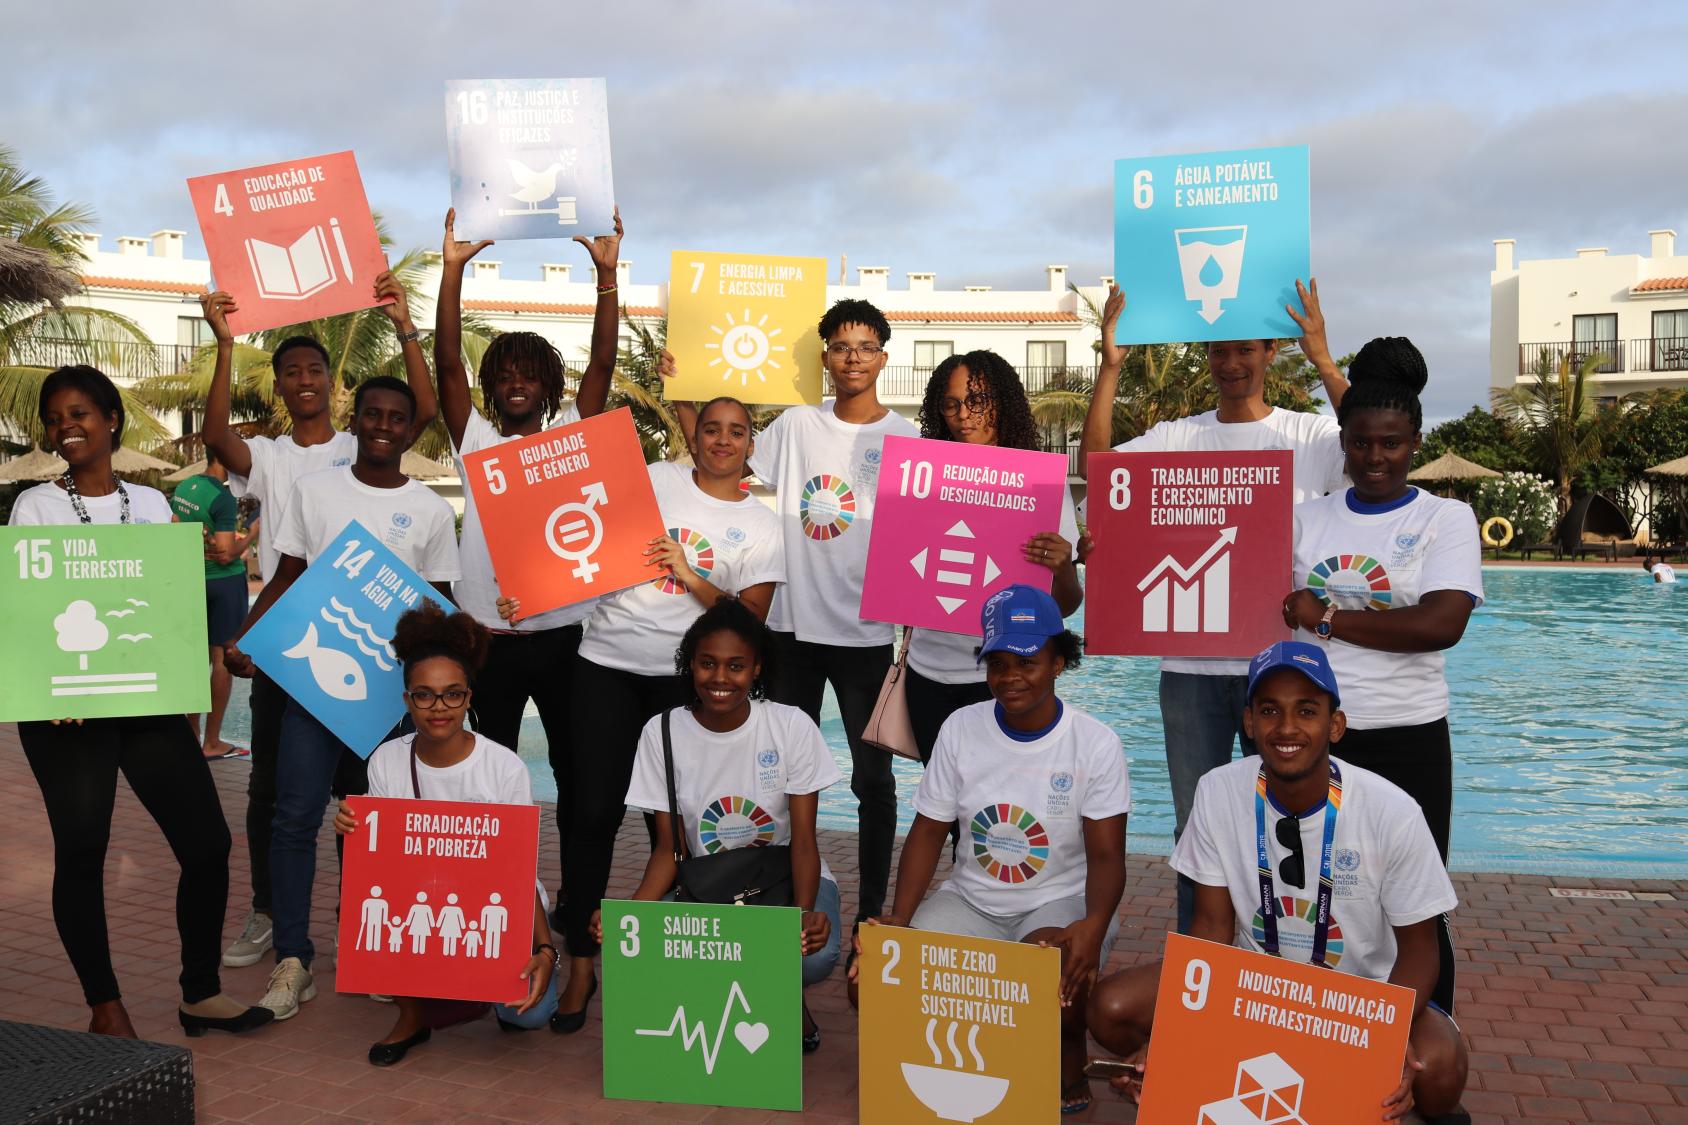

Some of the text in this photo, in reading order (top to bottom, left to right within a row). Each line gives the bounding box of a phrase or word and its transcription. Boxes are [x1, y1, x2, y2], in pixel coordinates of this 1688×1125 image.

[456, 90, 488, 124] 16
[496, 90, 579, 108] PAZ, JUSTIÇA E
[497, 107, 574, 126] INSTITUIÇÕES
[498, 128, 551, 143] EFICAZES
[244, 166, 325, 194] EDUCAÇÃO DE
[1175, 160, 1274, 186] ÁGUA POTÁVEL
[214, 183, 234, 216] 4
[249, 186, 316, 212] QUALIDADE
[1133, 170, 1154, 210] 6
[1176, 182, 1278, 208] E SANEAMENTO
[690, 262, 705, 294] 7
[720, 264, 804, 281] ENERGIA LIMPA
[720, 280, 786, 297] E ACESSÍVEL
[519, 432, 586, 466] IGUALDADE
[482, 458, 508, 496] 5
[524, 467, 542, 486] DE
[900, 459, 933, 500] 10
[943, 464, 1024, 488] REDUÇÃO DAS
[1109, 468, 1132, 511] 8
[1151, 466, 1280, 486] TRABALHO DECENTE
[940, 486, 1037, 512] DESIGUALDADES
[1151, 487, 1252, 506] E CRESCIMENTO
[1151, 504, 1226, 526] ECONÓMICO
[14, 539, 53, 580] 15
[62, 538, 98, 557] VIDA
[332, 539, 376, 580] 14
[63, 560, 144, 579] TERRESTRE
[360, 579, 393, 612] ÁGUA
[376, 564, 419, 608] VIDA NA
[366, 810, 379, 852] 1
[406, 812, 500, 839] ERRADICAÇÃO
[404, 836, 488, 859] DA POBREZA
[620, 914, 640, 958] 3
[664, 913, 720, 937] SAÚDE E
[664, 939, 742, 962] BEM-ESTAR
[881, 940, 901, 985] 2
[921, 944, 997, 974] FOME ZERO
[922, 970, 1030, 1004] E AGRICULTURA
[1182, 958, 1211, 1011] 9
[1238, 968, 1396, 1024] INDUSTRIA, INOVAÇÃO
[921, 994, 1016, 1028] SUSTENTÁVEL
[1233, 997, 1369, 1049] E INFRAESTRUTURA
